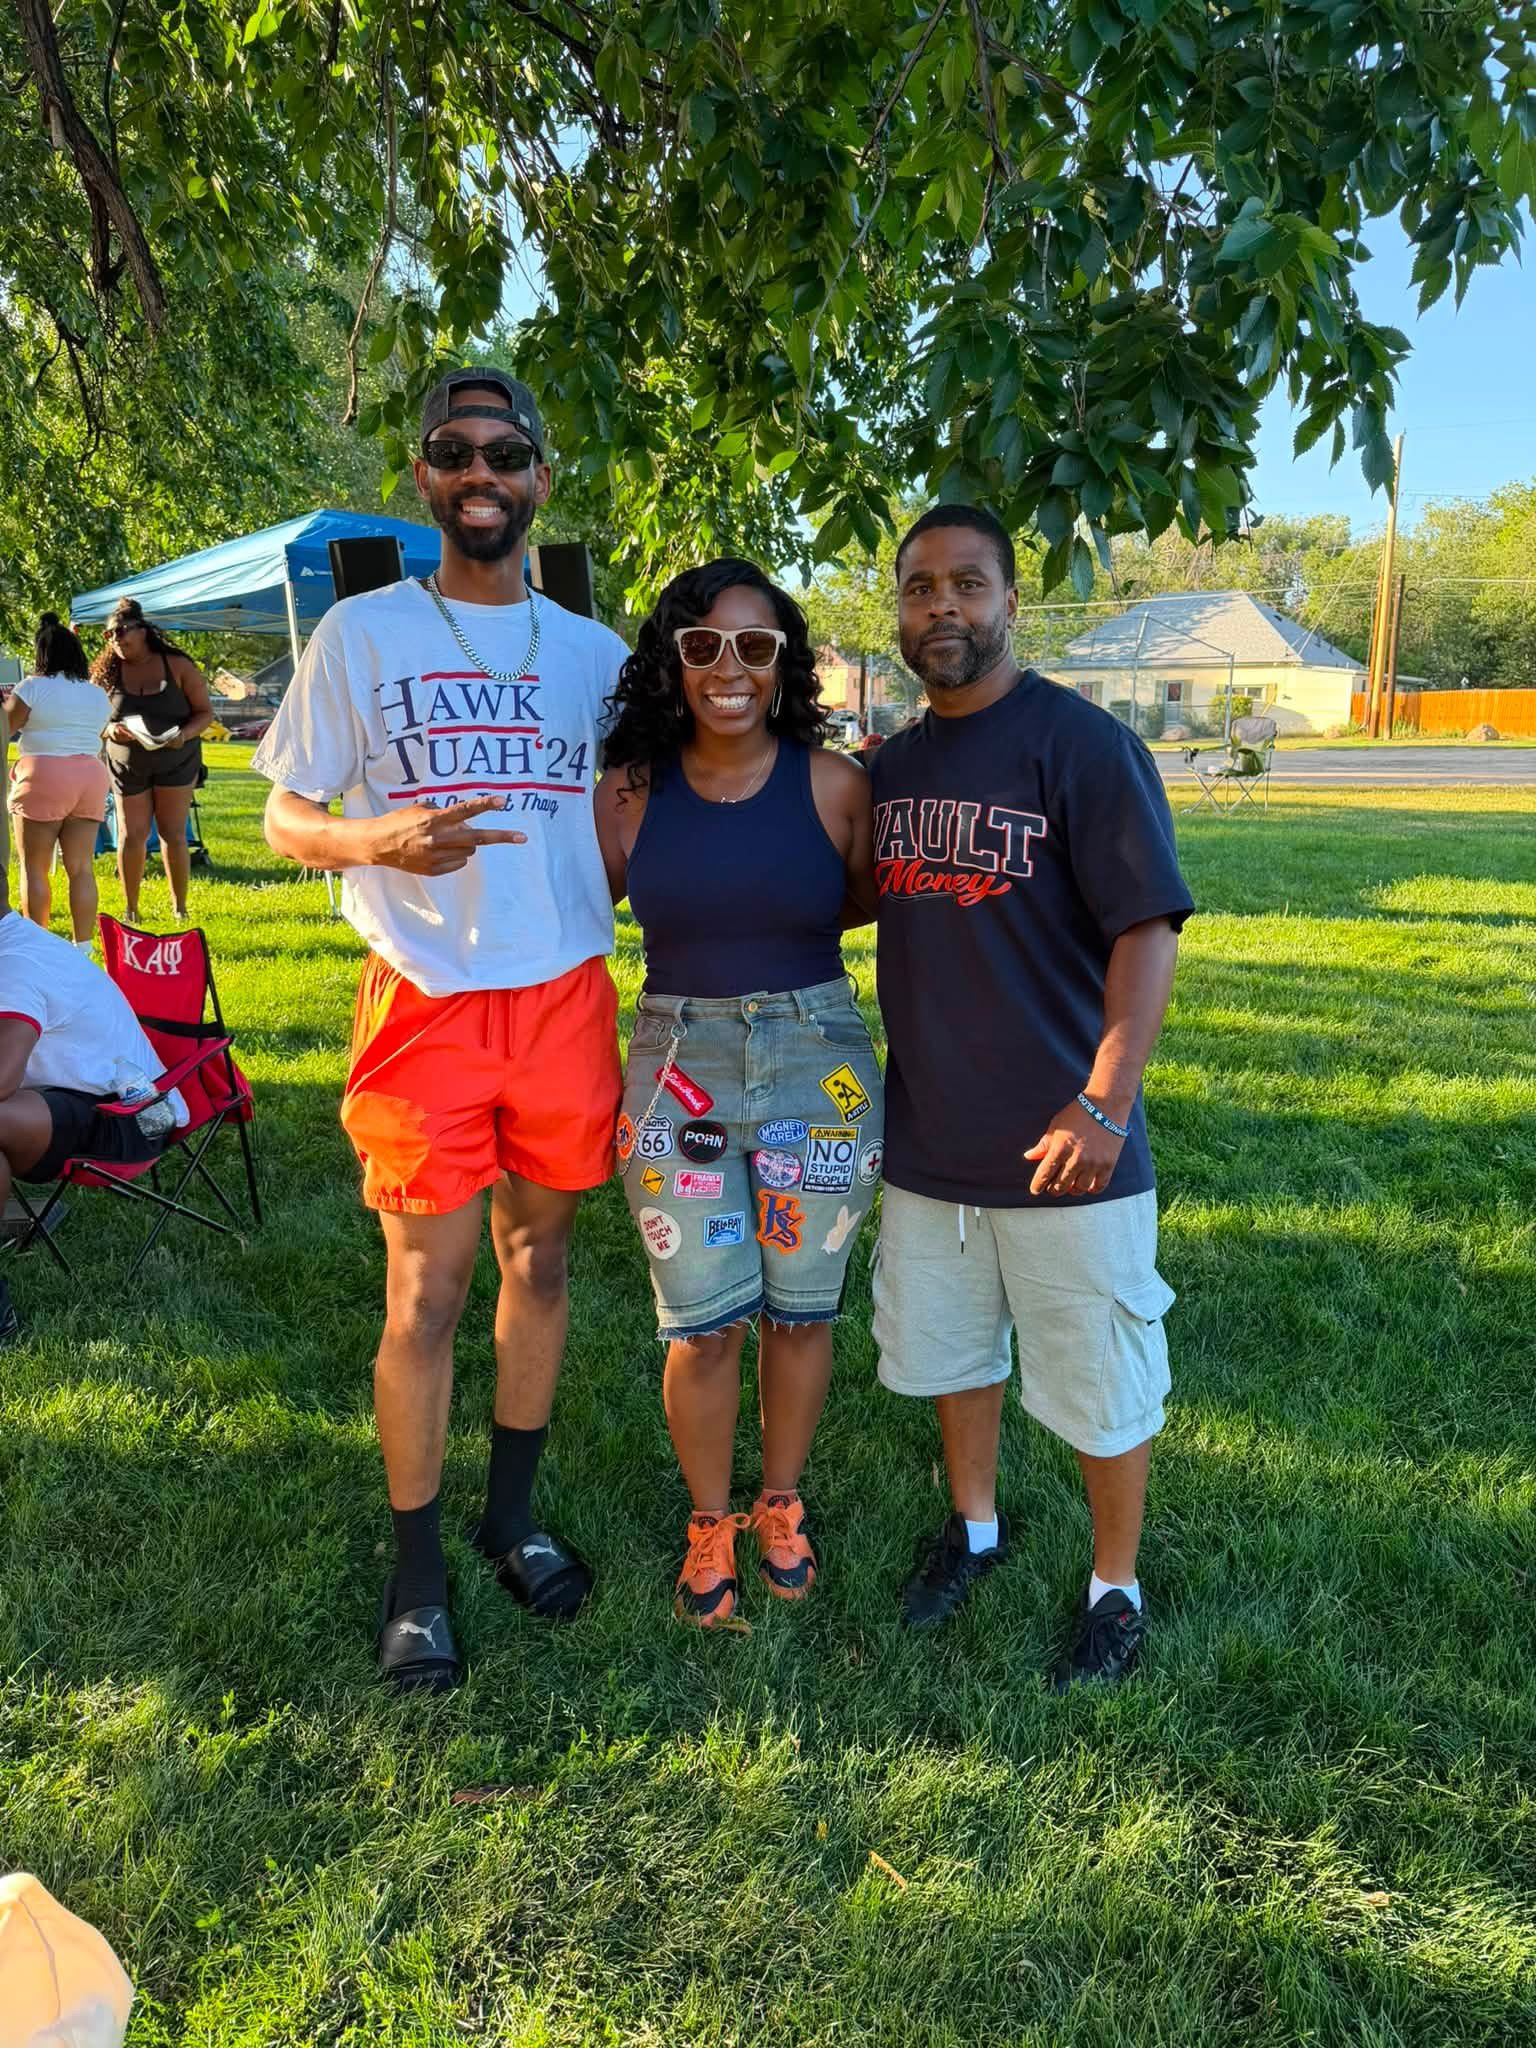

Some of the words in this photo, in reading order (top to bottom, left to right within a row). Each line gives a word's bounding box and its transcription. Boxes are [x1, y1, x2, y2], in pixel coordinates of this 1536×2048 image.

[374, 676, 545, 736] HAWK
[387, 732, 533, 785] TUAH
[874, 858, 1012, 907] Money
[641, 1132, 665, 1153] 66
[684, 1130, 724, 1149] PORN
[812, 1140, 853, 1163] NO
[808, 1173, 850, 1185] PEOPLE
[811, 1163, 851, 1174] STUPID
[656, 1239, 671, 1252] ME
